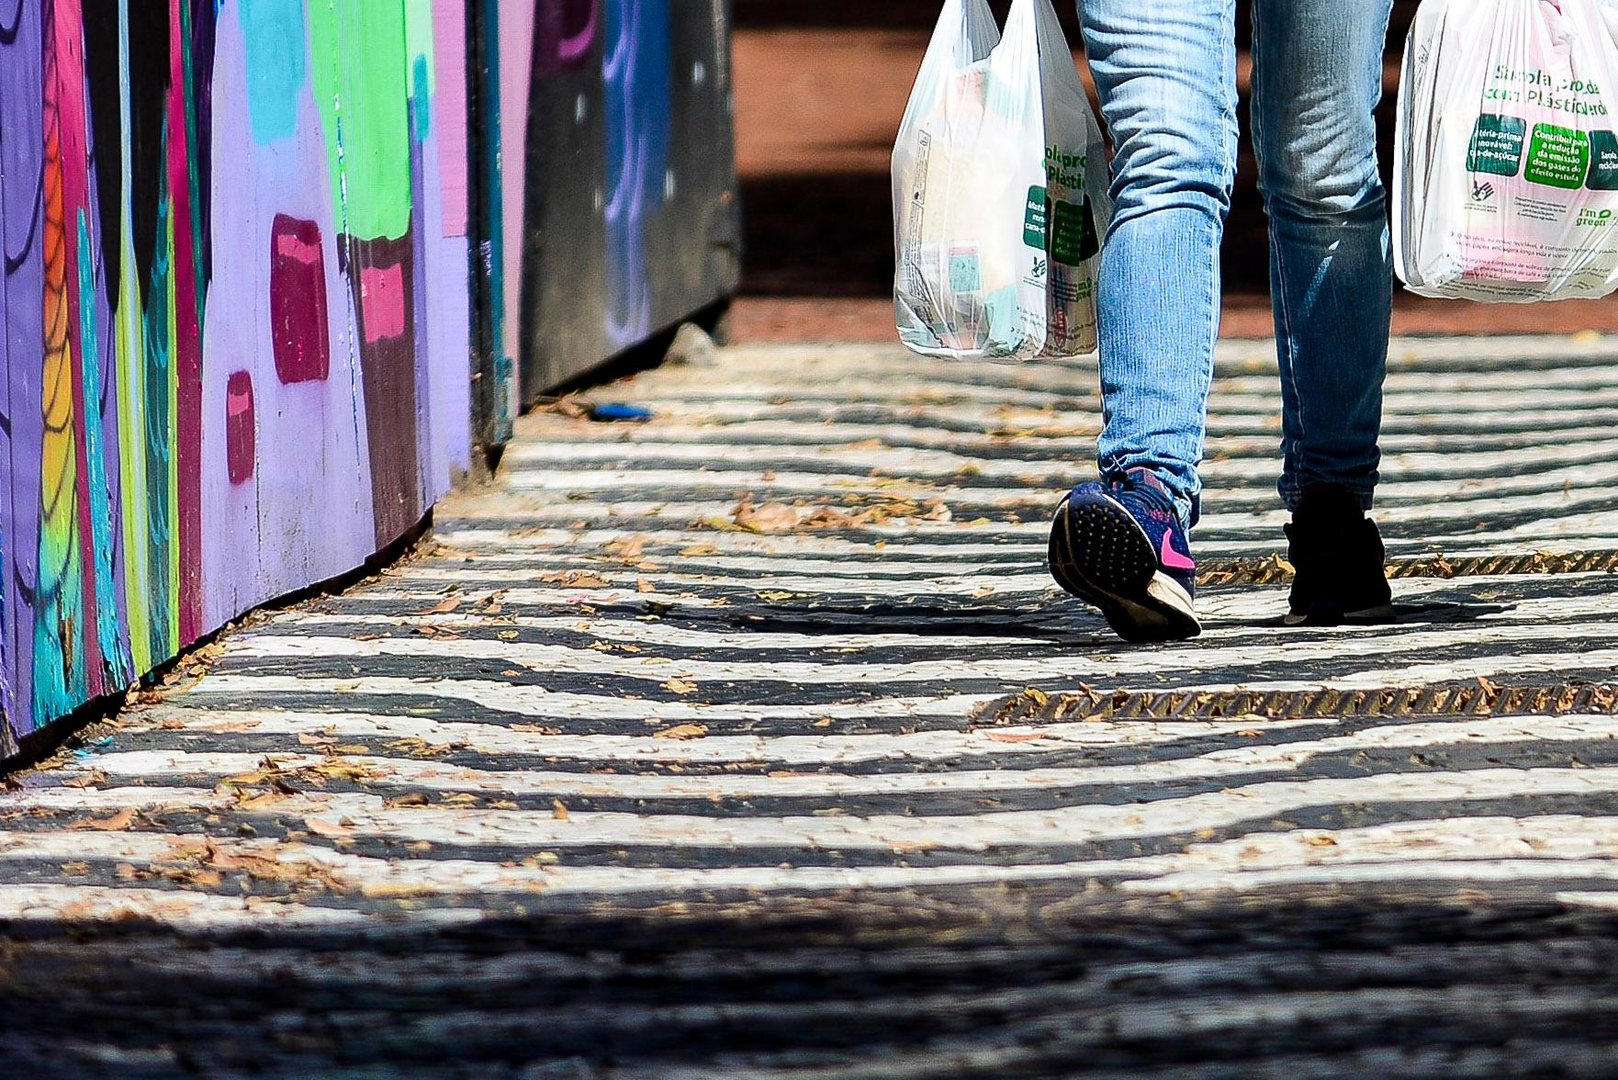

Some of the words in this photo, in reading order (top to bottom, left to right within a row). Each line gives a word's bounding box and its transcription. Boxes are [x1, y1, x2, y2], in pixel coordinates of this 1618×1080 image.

[1537, 149, 1548, 159] da
[1548, 153, 1581, 165] emissão
[1532, 157, 1548, 168] dos
[1547, 162, 1570, 173] gases
[1530, 167, 1554, 178] efeito
[1578, 207, 1597, 218] I'm
[1576, 217, 1606, 227] green
